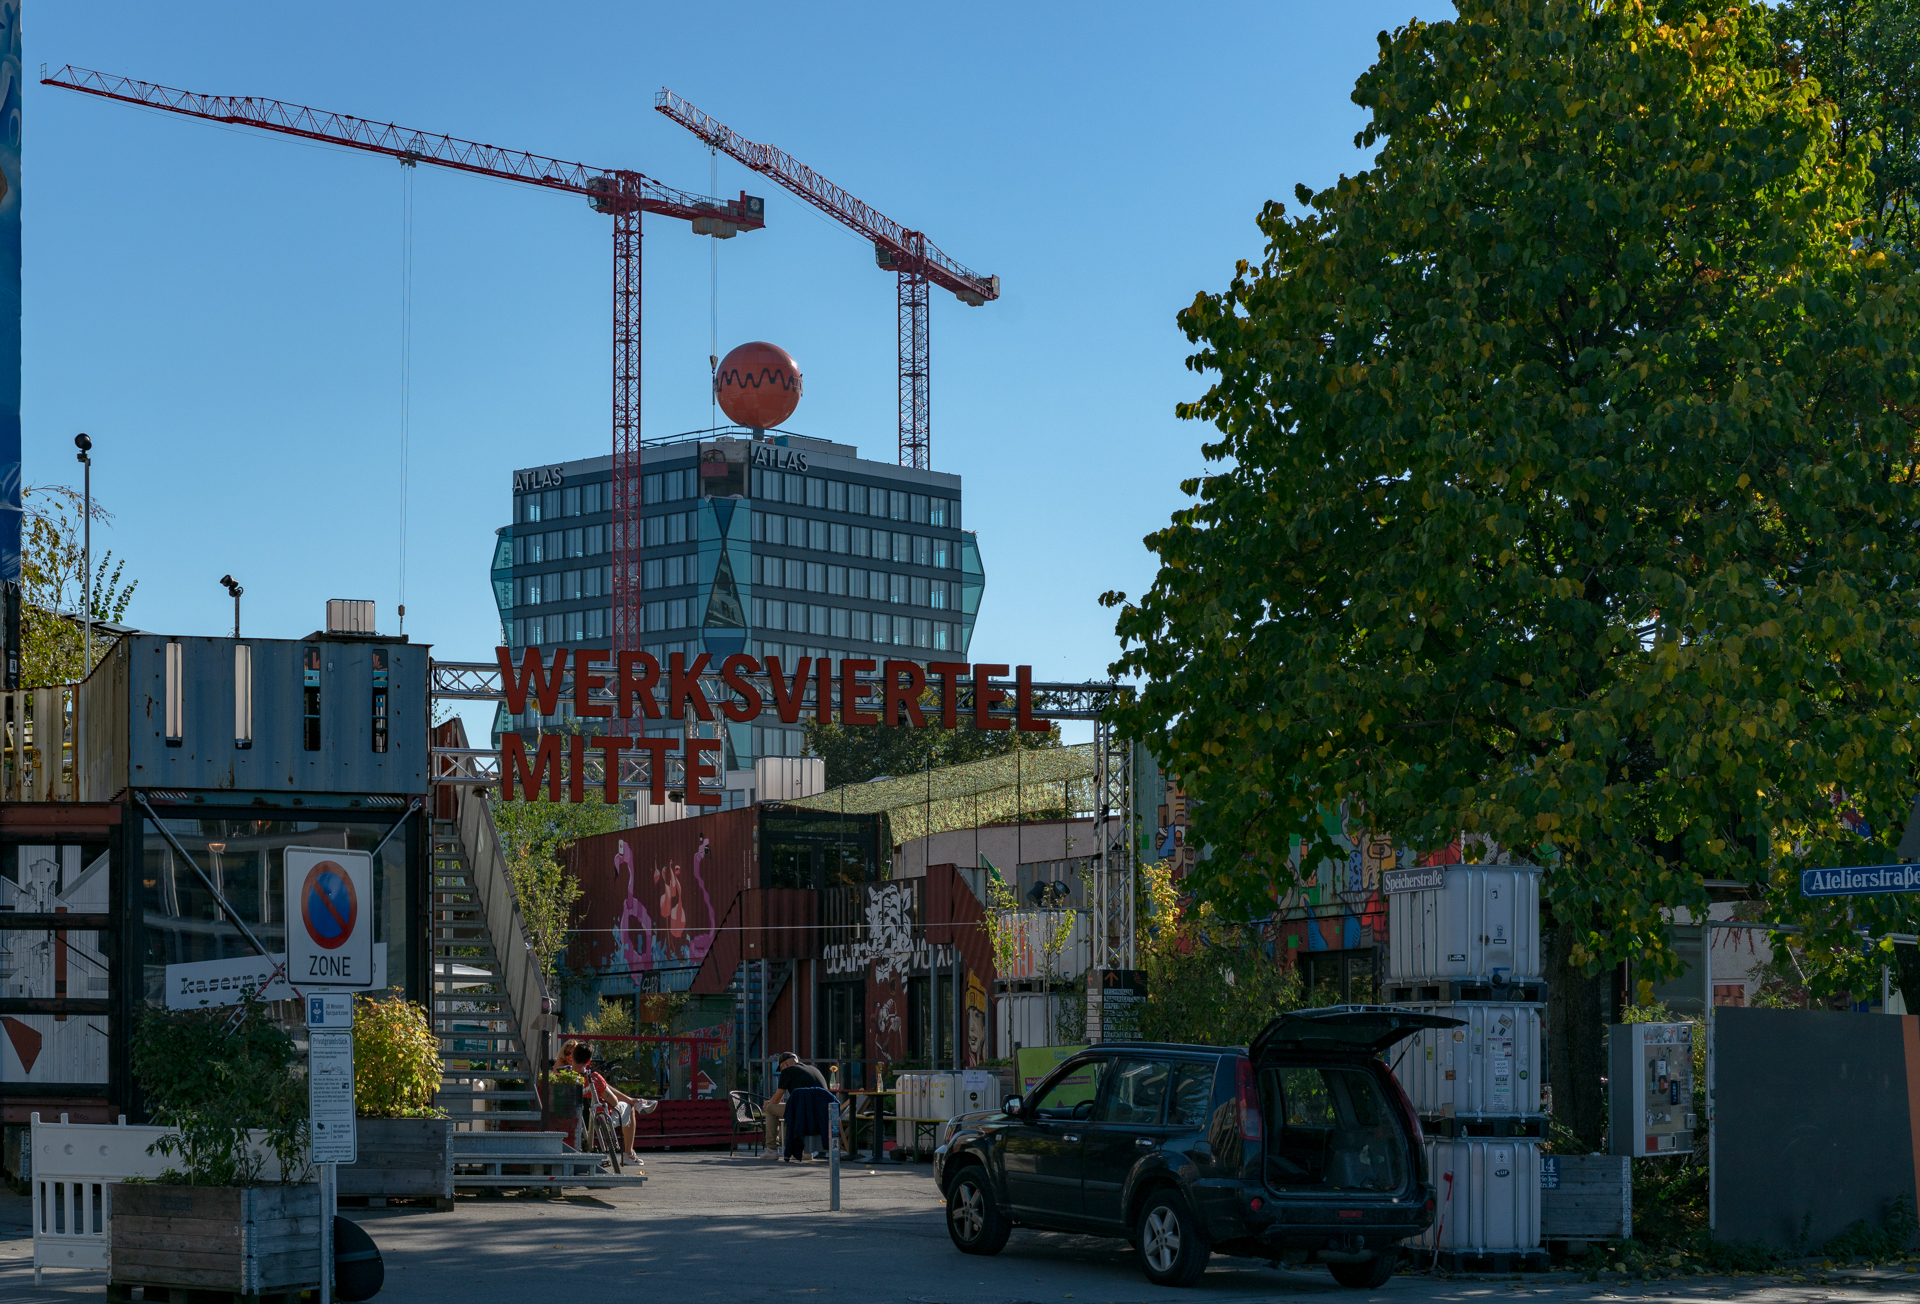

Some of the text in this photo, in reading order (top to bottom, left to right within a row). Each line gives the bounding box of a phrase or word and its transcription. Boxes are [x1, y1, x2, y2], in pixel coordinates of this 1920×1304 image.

[752, 446, 809, 473] ATLAS
[513, 466, 564, 493] ATLAS
[496, 647, 1051, 731] WERKSVIERTEL
[502, 733, 722, 806] MITTE
[1385, 870, 1443, 891] Speicherstraße
[1811, 867, 1920, 890] Atelierstraße
[309, 955, 351, 977] ZONE
[181, 973, 267, 994] kaserne
[313, 1037, 348, 1046] Privatgrundstück
[1541, 1157, 1555, 1173] 14
[233, 1226, 240, 1236] 3
